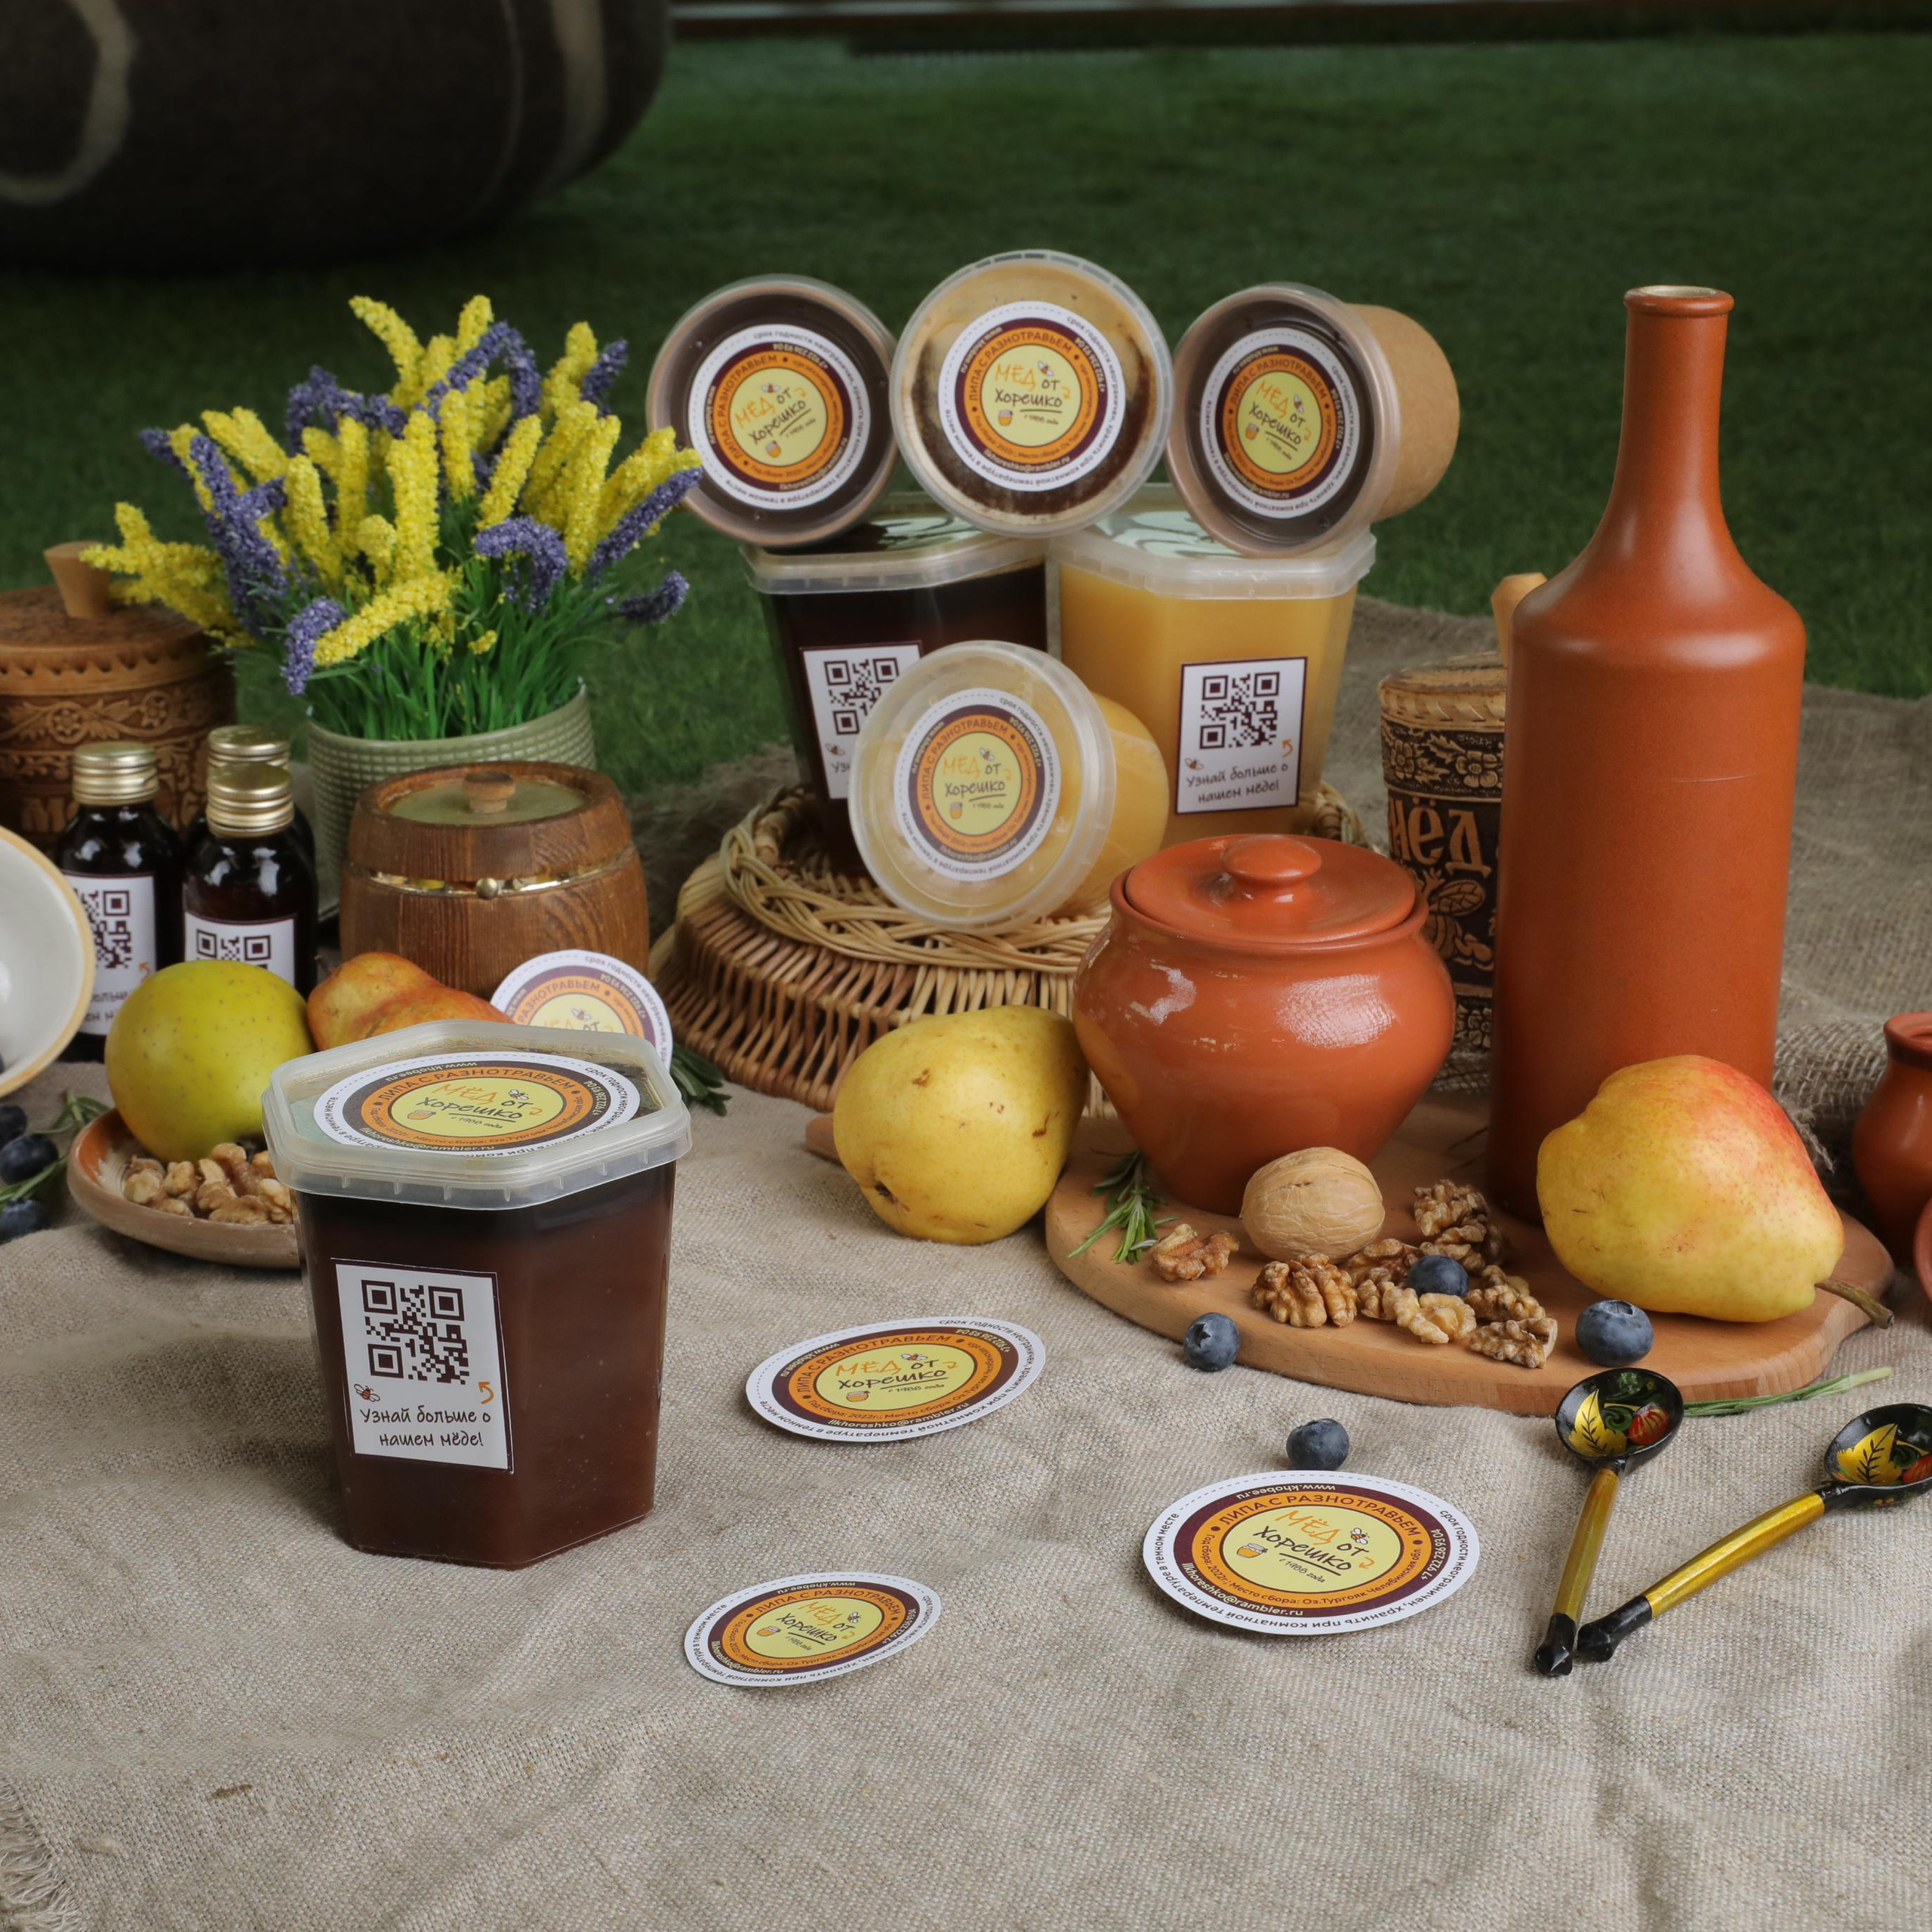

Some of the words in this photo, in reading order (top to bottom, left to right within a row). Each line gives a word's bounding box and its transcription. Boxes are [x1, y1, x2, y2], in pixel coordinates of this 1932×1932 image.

[969, 369, 983, 401] ЛИПА
[978, 358, 988, 367] С
[984, 331, 1072, 359] РАЗНОТРАВЬЕМ
[994, 363, 1036, 392] МЁД
[1041, 378, 1060, 391] от
[921, 766, 932, 799] ЛИПА
[927, 755, 935, 764] С
[931, 718, 1008, 755] РАЗНОТРАВЬЕМ
[943, 755, 980, 780] МЁД
[984, 762, 1001, 775] от
[1186, 771, 1226, 788] Узнай
[1230, 764, 1278, 781] больше
[1281, 764, 1289, 772] о
[1198, 787, 1241, 804] нашем
[1246, 780, 1279, 797] мёде!
[377, 1081, 419, 1100] ЛИПА
[434, 1069, 576, 1089] РАЗНОТРАВЬЕМ
[796, 1371, 815, 1392] ЛИПА
[816, 1334, 952, 1364] РАЗНОТРАВЬЕМ
[835, 1360, 902, 1377] МЁД
[910, 1358, 940, 1370] от
[360, 1407, 411, 1423] Узнай
[417, 1404, 477, 1423] больше
[482, 1412, 491, 1423] о
[379, 1432, 434, 1447] нашем
[440, 1430, 484, 1447] мёде!
[1158, 1513, 1180, 1535] месте
[1219, 1502, 1267, 1525] ЛИПА
[1269, 1497, 1283, 1506] С
[1286, 1494, 1421, 1536] РАЗНОТРАВЬЕМ
[1439, 1510, 1460, 1527] срок
[1275, 1509, 1340, 1546] МЁД
[1336, 1543, 1370, 1556] от
[1454, 1527, 1469, 1561] годности
[1155, 1536, 1165, 1565] темном
[1253, 1525, 1352, 1571] Хорешко
[1284, 1560, 1308, 1574] 1988
[1306, 1572, 1326, 1583] года
[1162, 1571, 1224, 1614] температуре
[1226, 1611, 1308, 1629] комнатной
[1344, 1606, 1404, 1624] хранить
